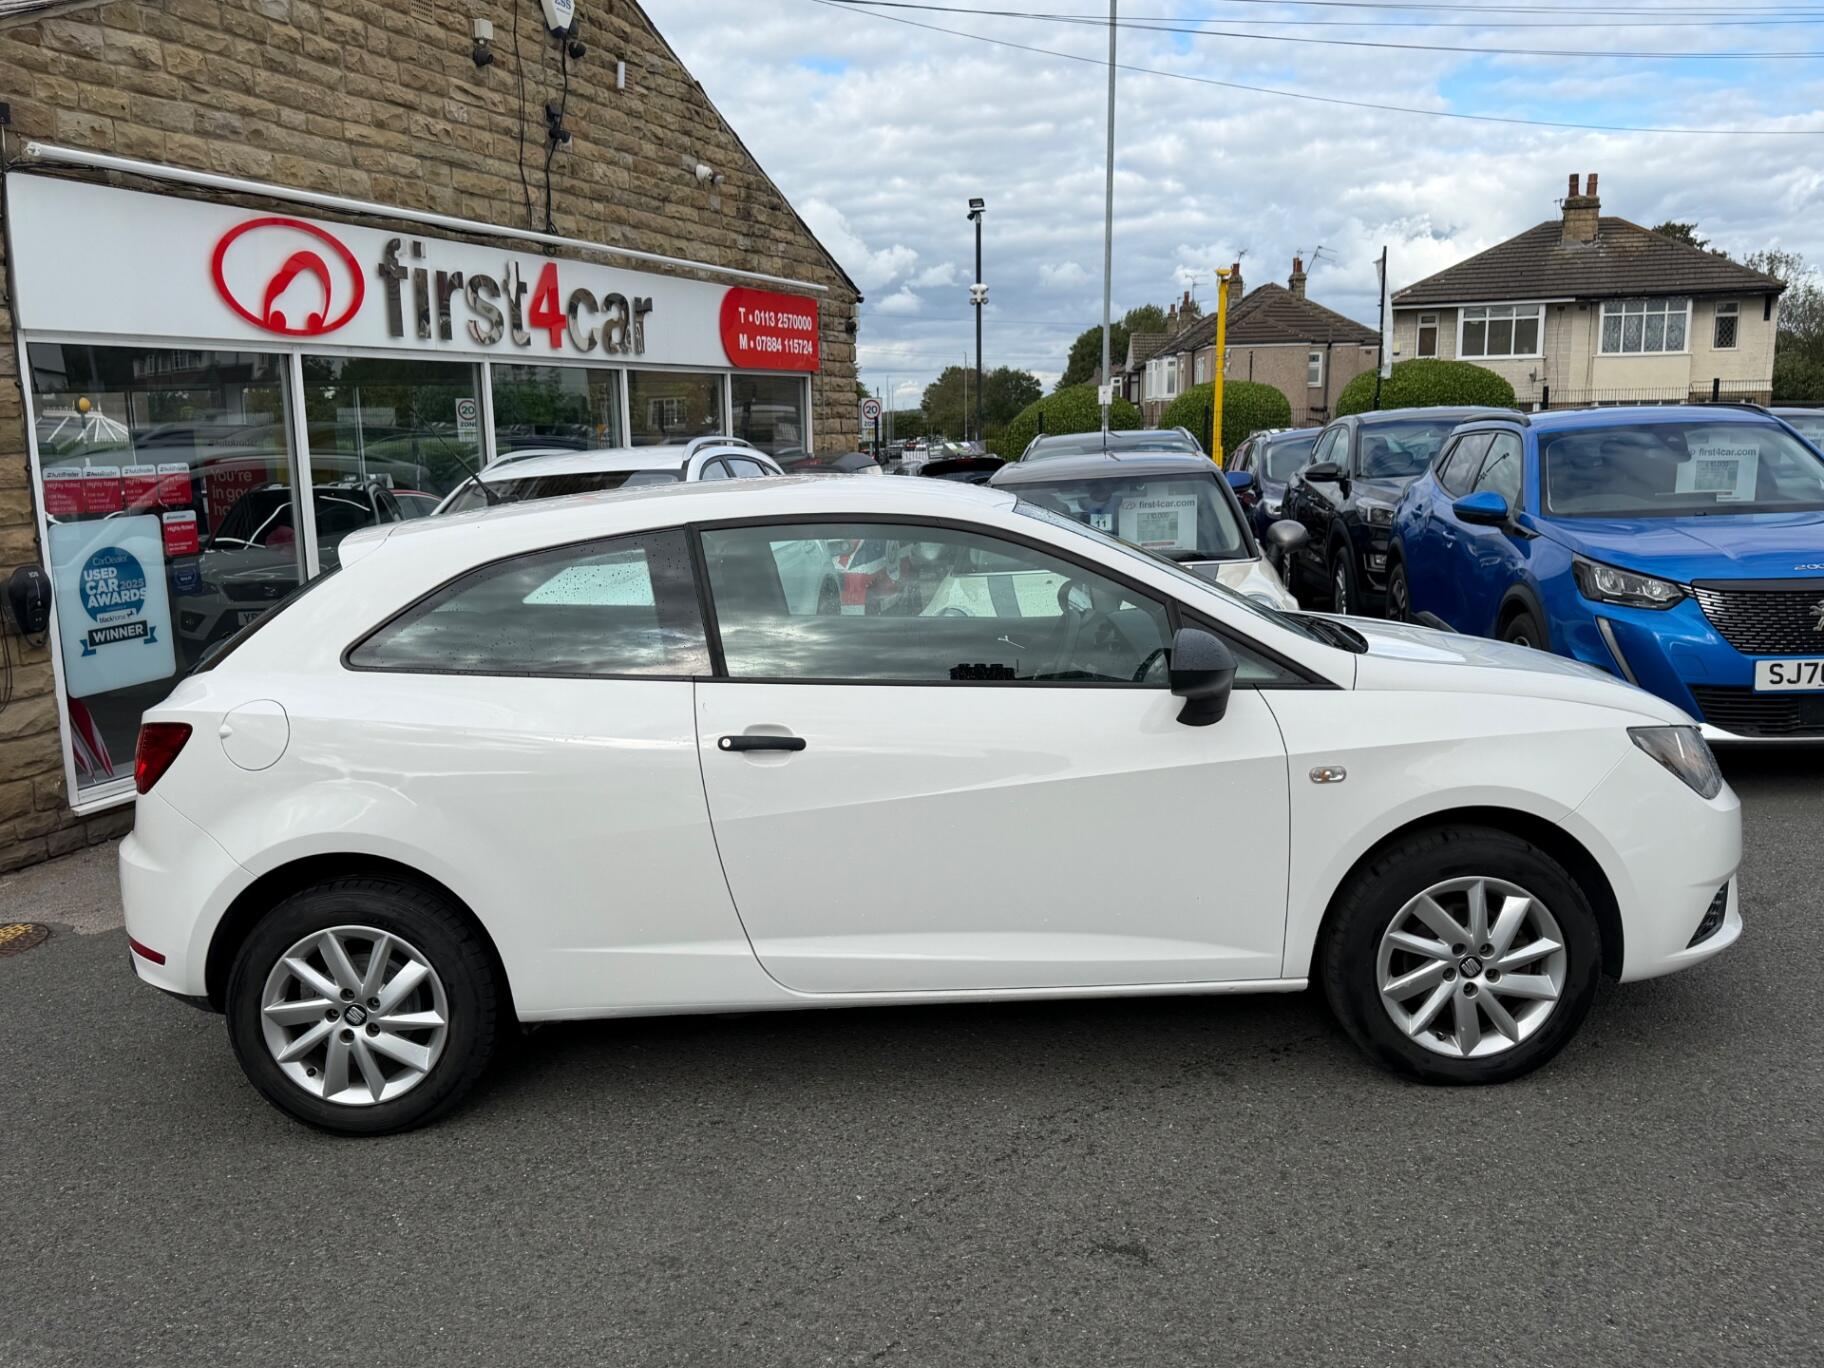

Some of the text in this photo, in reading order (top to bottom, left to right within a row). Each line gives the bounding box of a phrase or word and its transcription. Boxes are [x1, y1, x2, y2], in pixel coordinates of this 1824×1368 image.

[378, 237, 653, 355] first4car
[738, 306, 812, 331] T 0113 2570000
[739, 333, 813, 354] M 07884 115724
[461, 405, 475, 415] 20
[865, 405, 878, 414] 20
[212, 485, 224, 499] in
[83, 566, 118, 581] USED
[85, 578, 145, 596] CAR 2025
[87, 587, 147, 609] AWARDS
[92, 623, 145, 643] WINNER
[1769, 662, 1824, 685] SJ7
